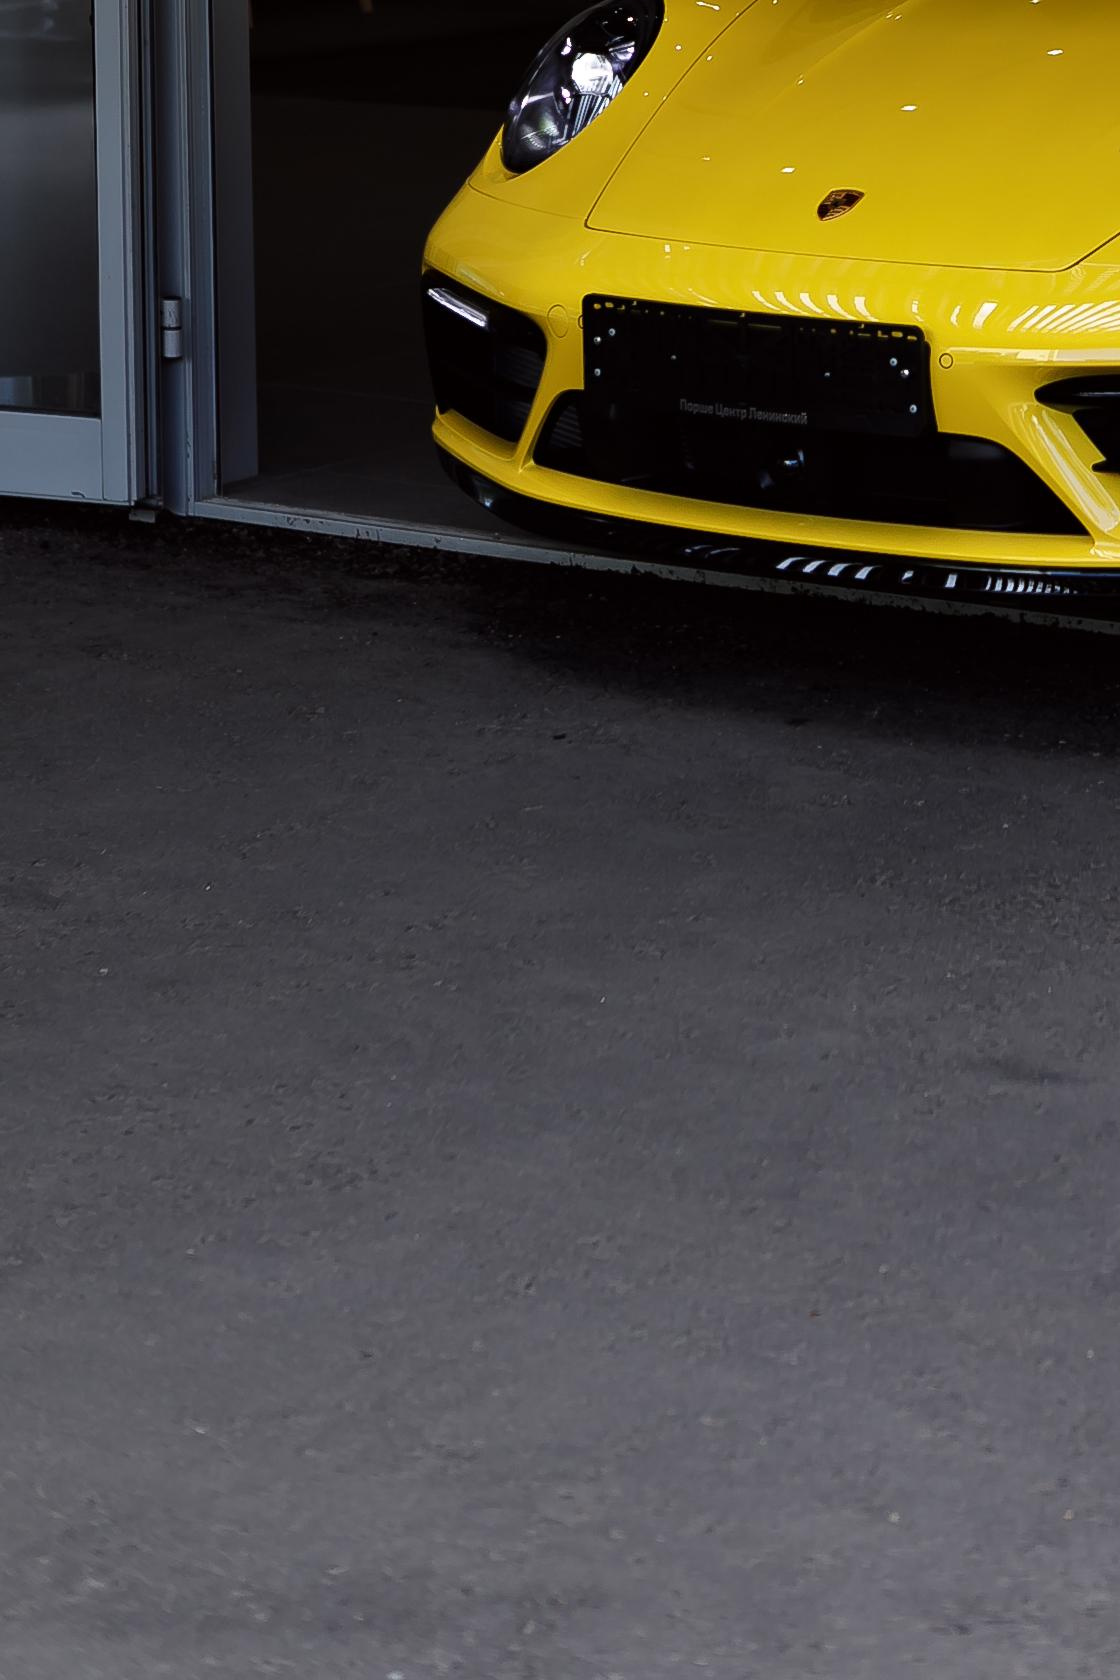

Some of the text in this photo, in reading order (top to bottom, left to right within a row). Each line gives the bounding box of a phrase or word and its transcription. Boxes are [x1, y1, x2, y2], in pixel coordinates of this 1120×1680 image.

[680, 398, 808, 425] Порше Центр Ленинский
